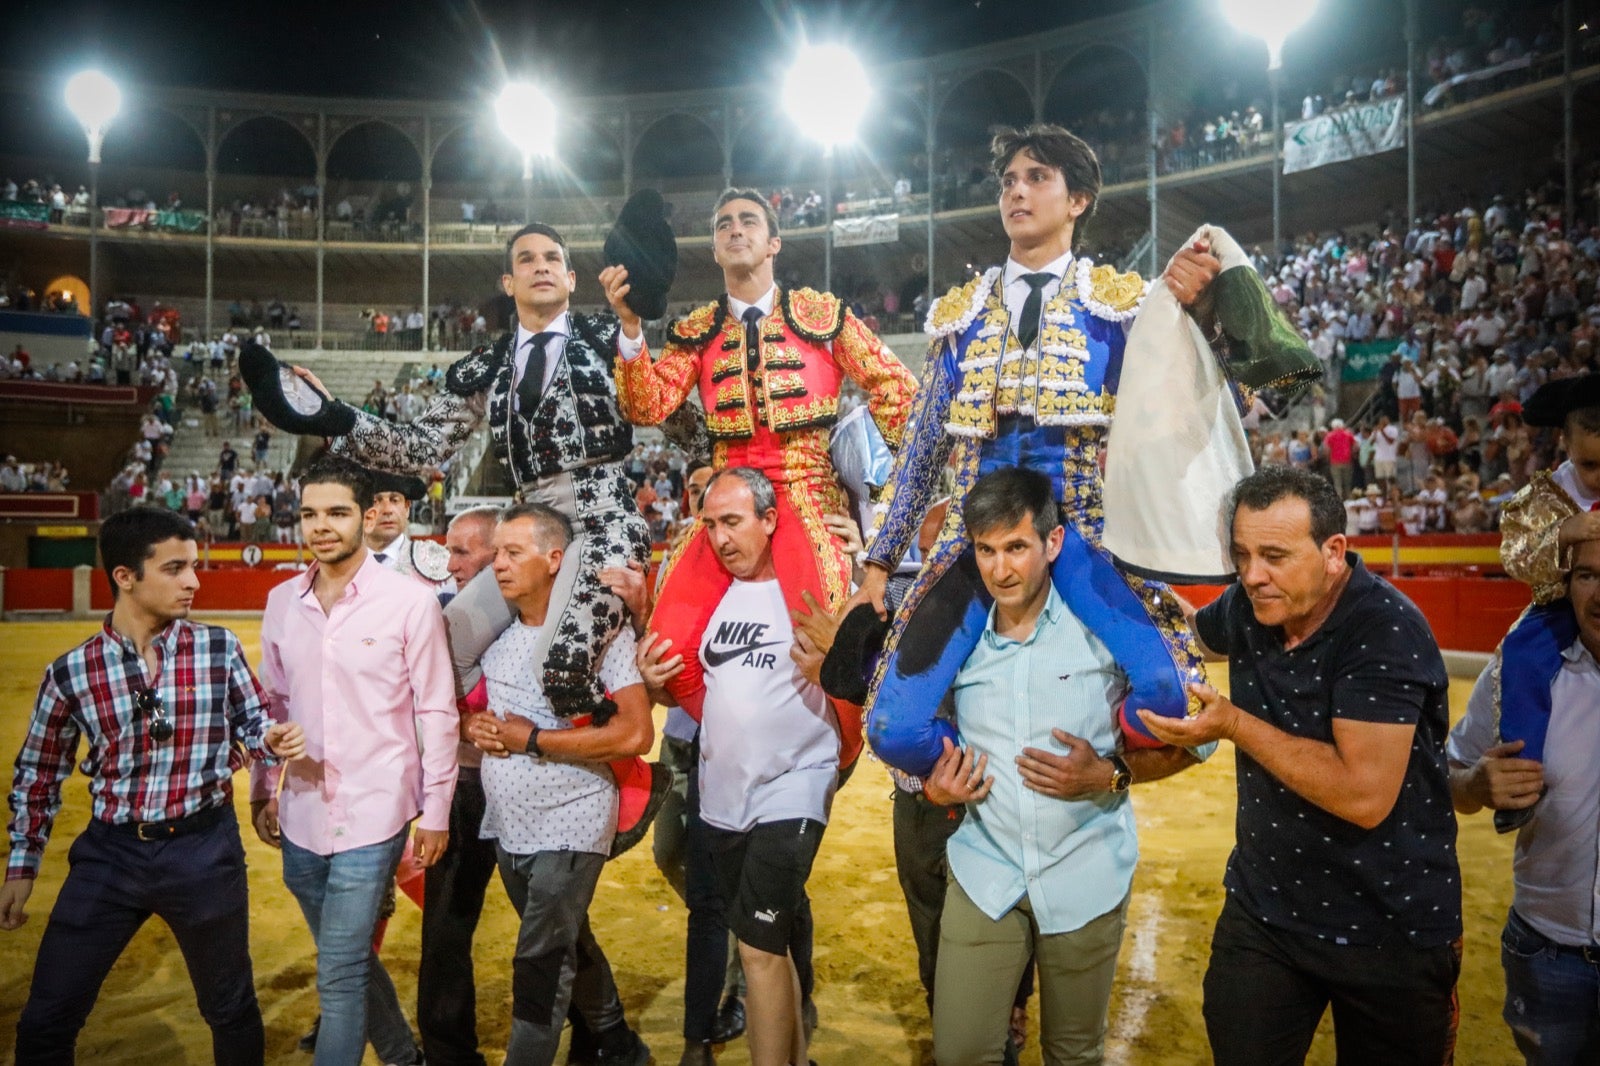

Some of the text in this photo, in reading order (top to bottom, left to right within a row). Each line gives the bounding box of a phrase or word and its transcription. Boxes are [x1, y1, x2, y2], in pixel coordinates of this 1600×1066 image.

[248, 548, 256, 562] 7
[713, 621, 770, 646] NIKE
[741, 652, 776, 670] AIR
[754, 910, 774, 923] PUMA
